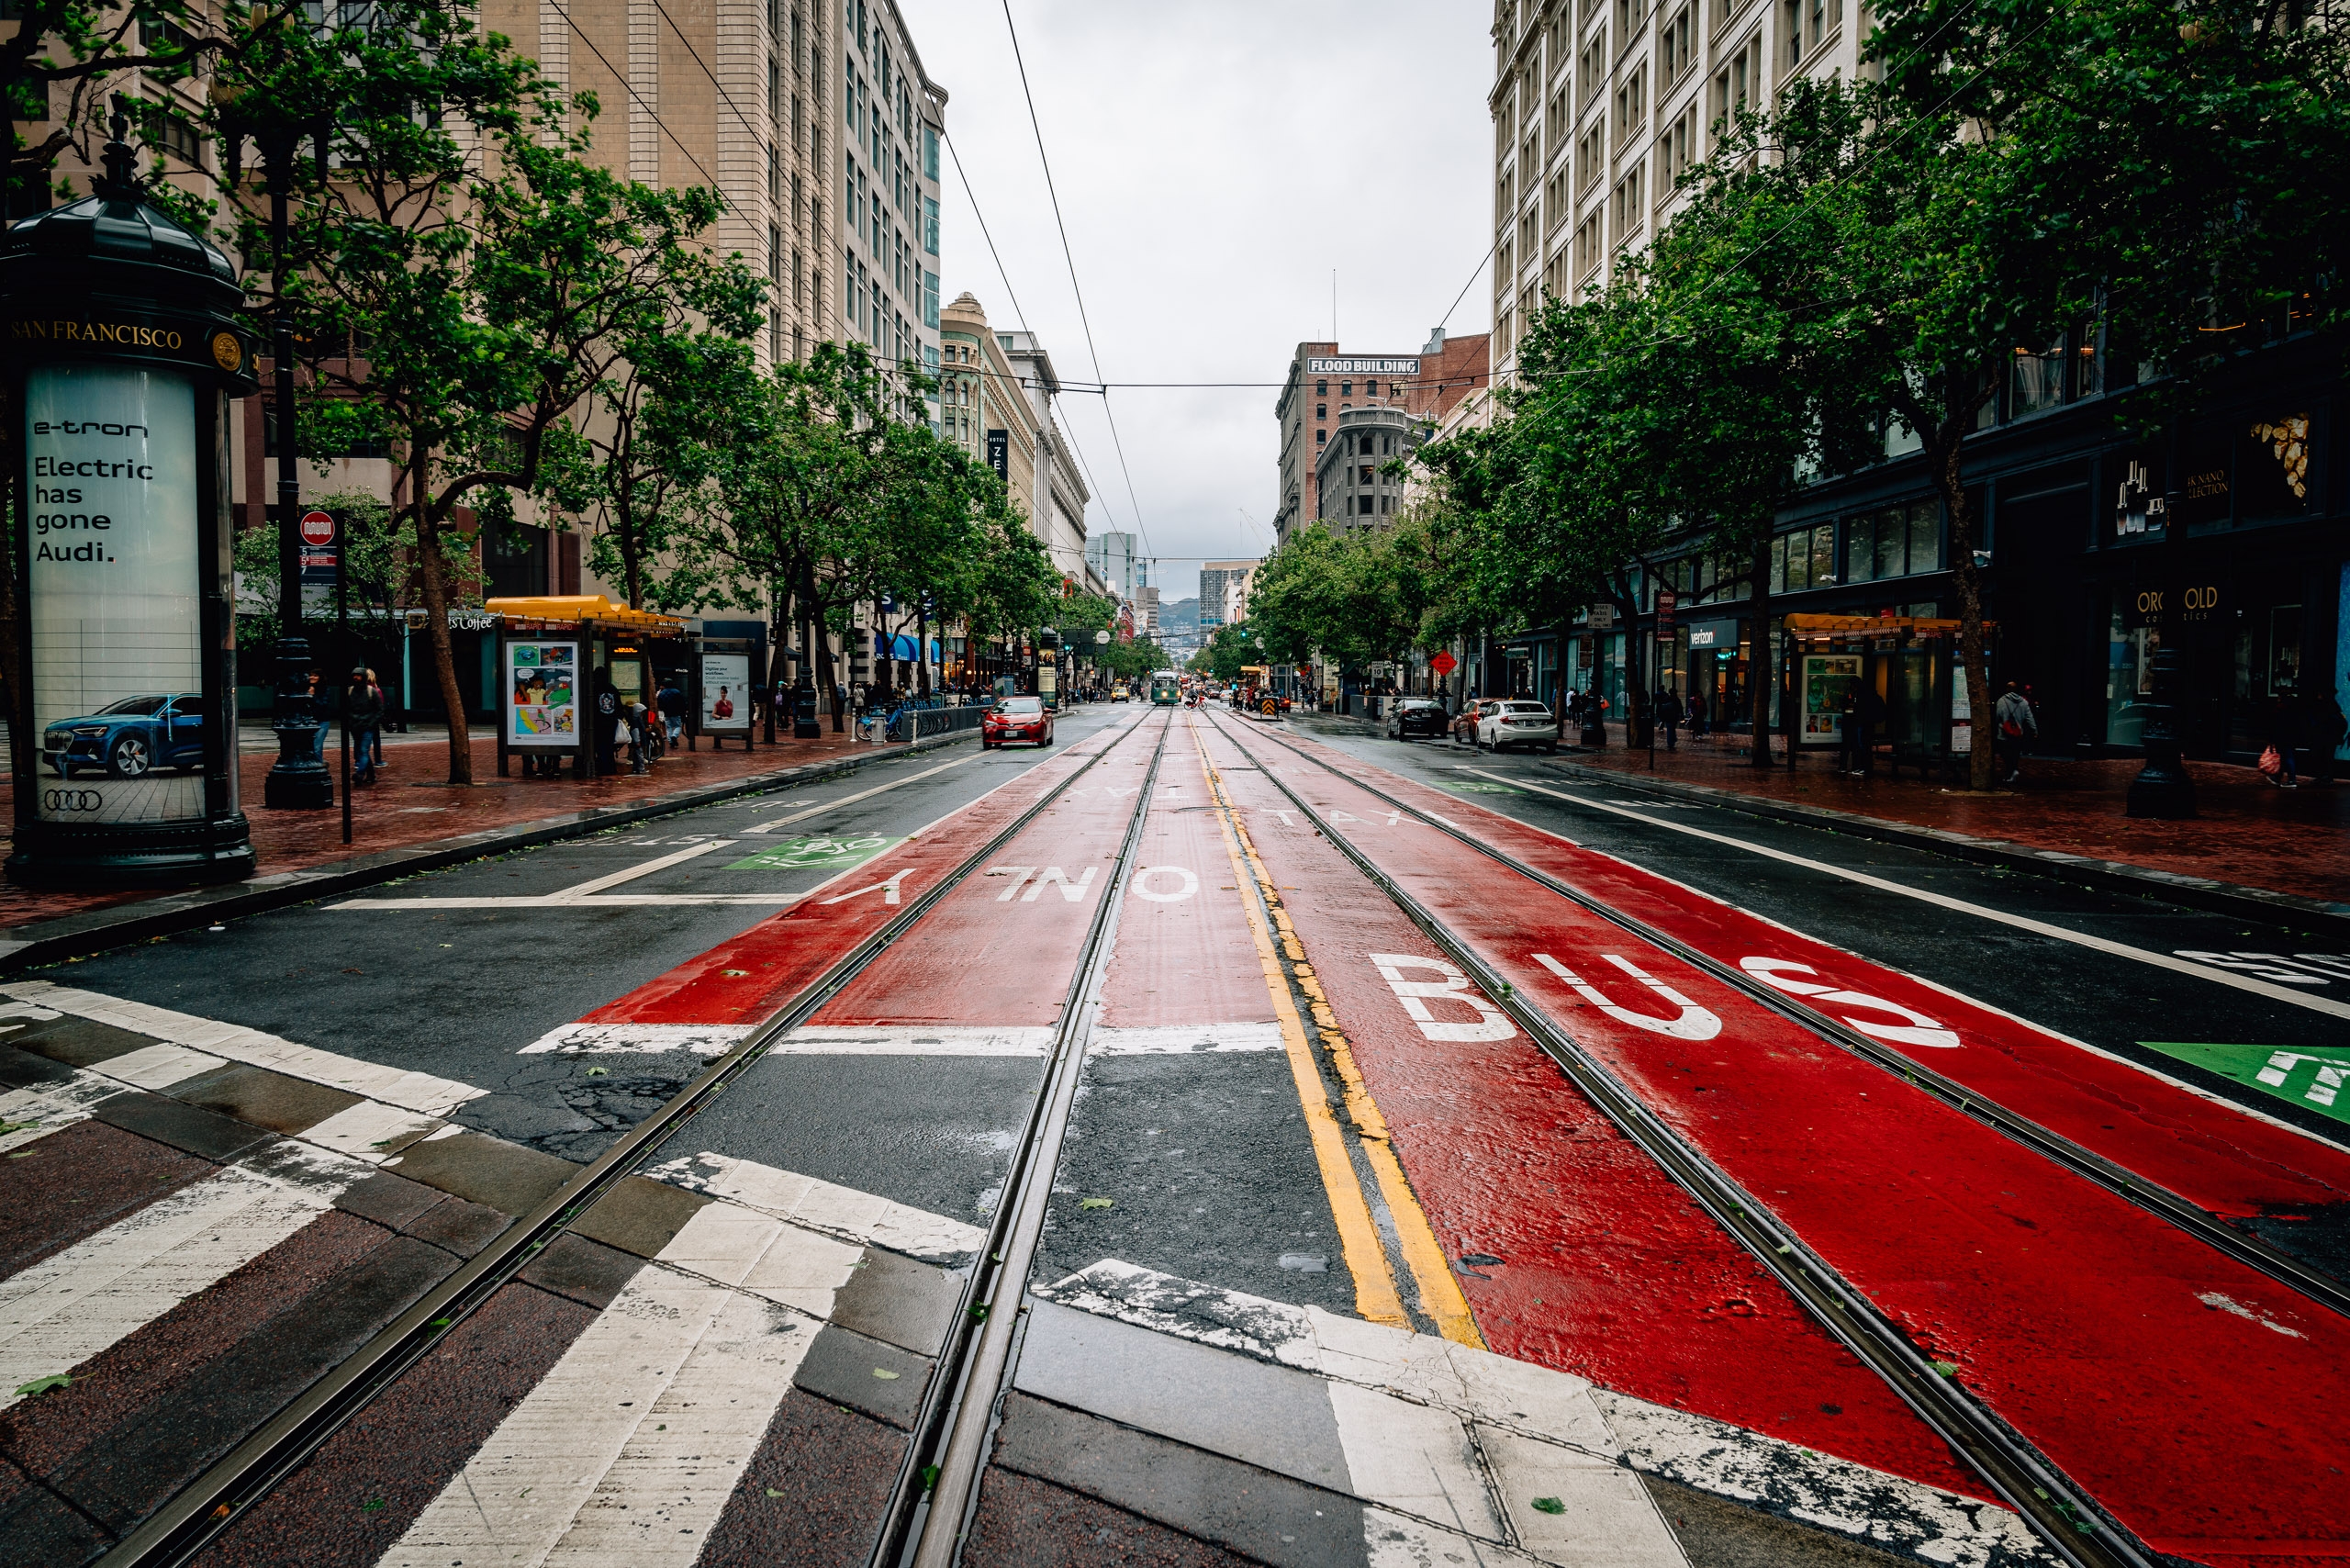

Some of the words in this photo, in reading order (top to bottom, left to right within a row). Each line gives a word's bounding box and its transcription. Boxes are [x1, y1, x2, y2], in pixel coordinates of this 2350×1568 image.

[10, 320, 47, 339] SAN
[52, 321, 183, 350] FRANCISCO
[1311, 360, 1352, 372] FLOOD
[1354, 359, 1416, 373] BUILDING
[34, 420, 149, 439] e-tron
[993, 446, 1002, 470] ZE
[35, 457, 153, 481] Electric
[2198, 469, 2224, 486] NANO
[36, 484, 83, 504] has
[36, 514, 111, 534] gone
[36, 542, 116, 563] Audi.
[301, 566, 307, 575] 7
[2137, 587, 2219, 613] OROOLD
[459, 613, 492, 631] Coffee
[1691, 629, 1713, 644] verizon
[1260, 809, 1461, 826] TAXI
[818, 866, 1199, 904] ONLY
[1368, 953, 1961, 1048] BUS
